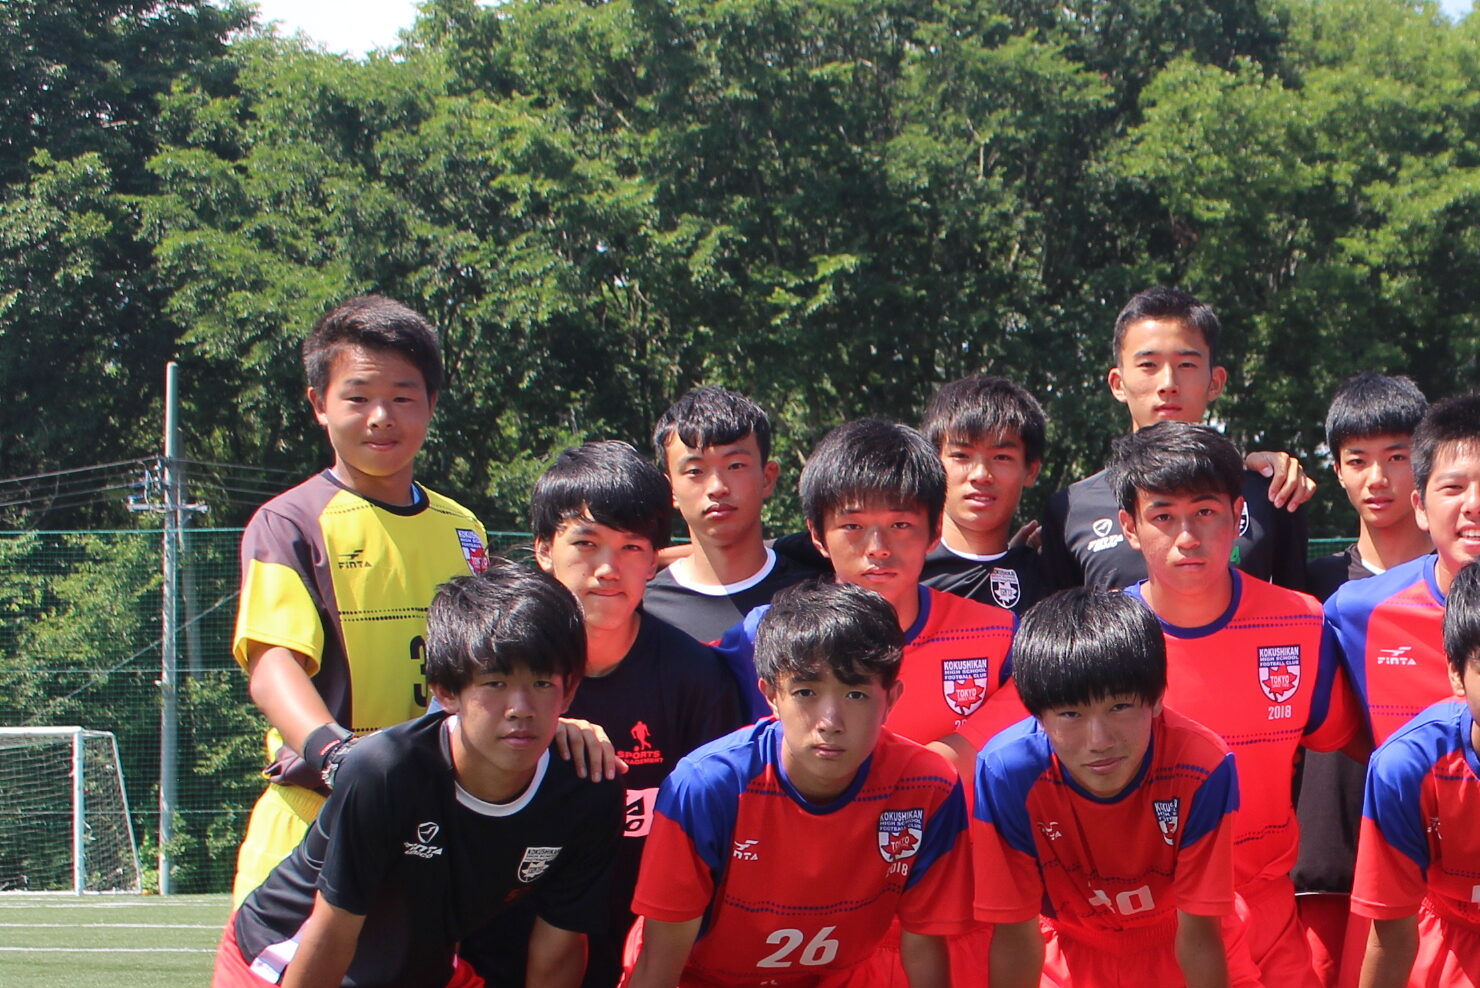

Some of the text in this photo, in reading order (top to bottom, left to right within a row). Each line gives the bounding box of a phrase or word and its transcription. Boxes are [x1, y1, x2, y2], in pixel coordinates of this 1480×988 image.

[1259, 646, 1299, 658] KOKUSHIKAN
[944, 659, 987, 671] KOKUSHIKAN
[1377, 657, 1417, 665] FINTA
[1270, 675, 1290, 684] TOKYO
[956, 688, 977, 698] TOKYO
[1268, 705, 1292, 720] 2018
[616, 750, 661, 759] SPORTS
[622, 757, 664, 766] NAGEMENT
[880, 810, 923, 822] KOKUSHIKAN
[733, 850, 759, 861] NTA
[756, 925, 839, 968] 26
